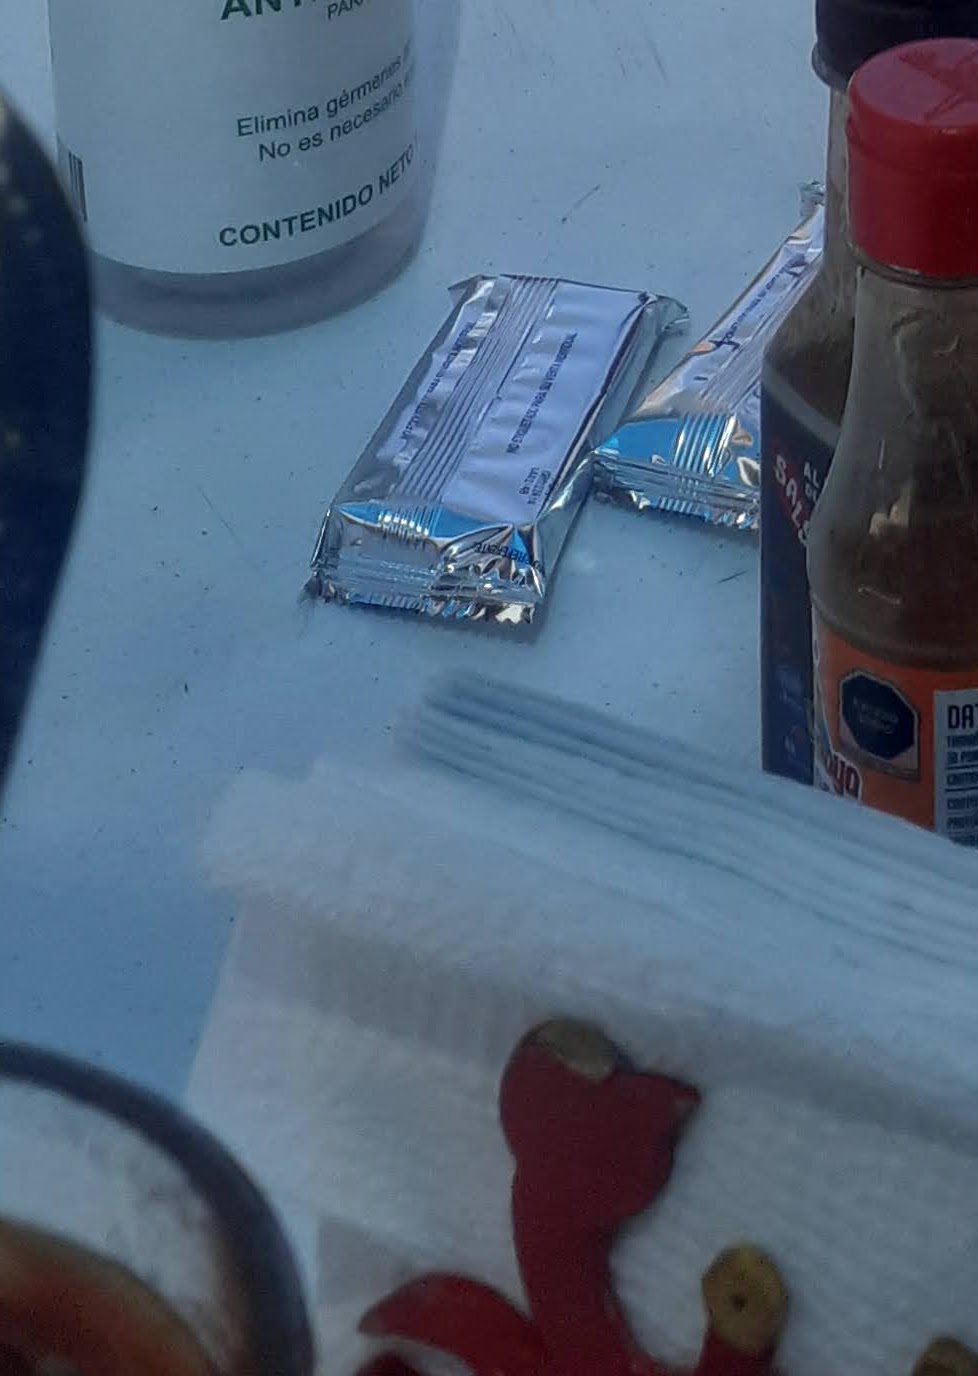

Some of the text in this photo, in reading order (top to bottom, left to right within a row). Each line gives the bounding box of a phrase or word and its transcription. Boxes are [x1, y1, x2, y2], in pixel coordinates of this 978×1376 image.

[237, 104, 319, 137] Elimina
[258, 141, 291, 162] No
[298, 132, 323, 151] es
[219, 143, 414, 246] CONTENIDO NETO
